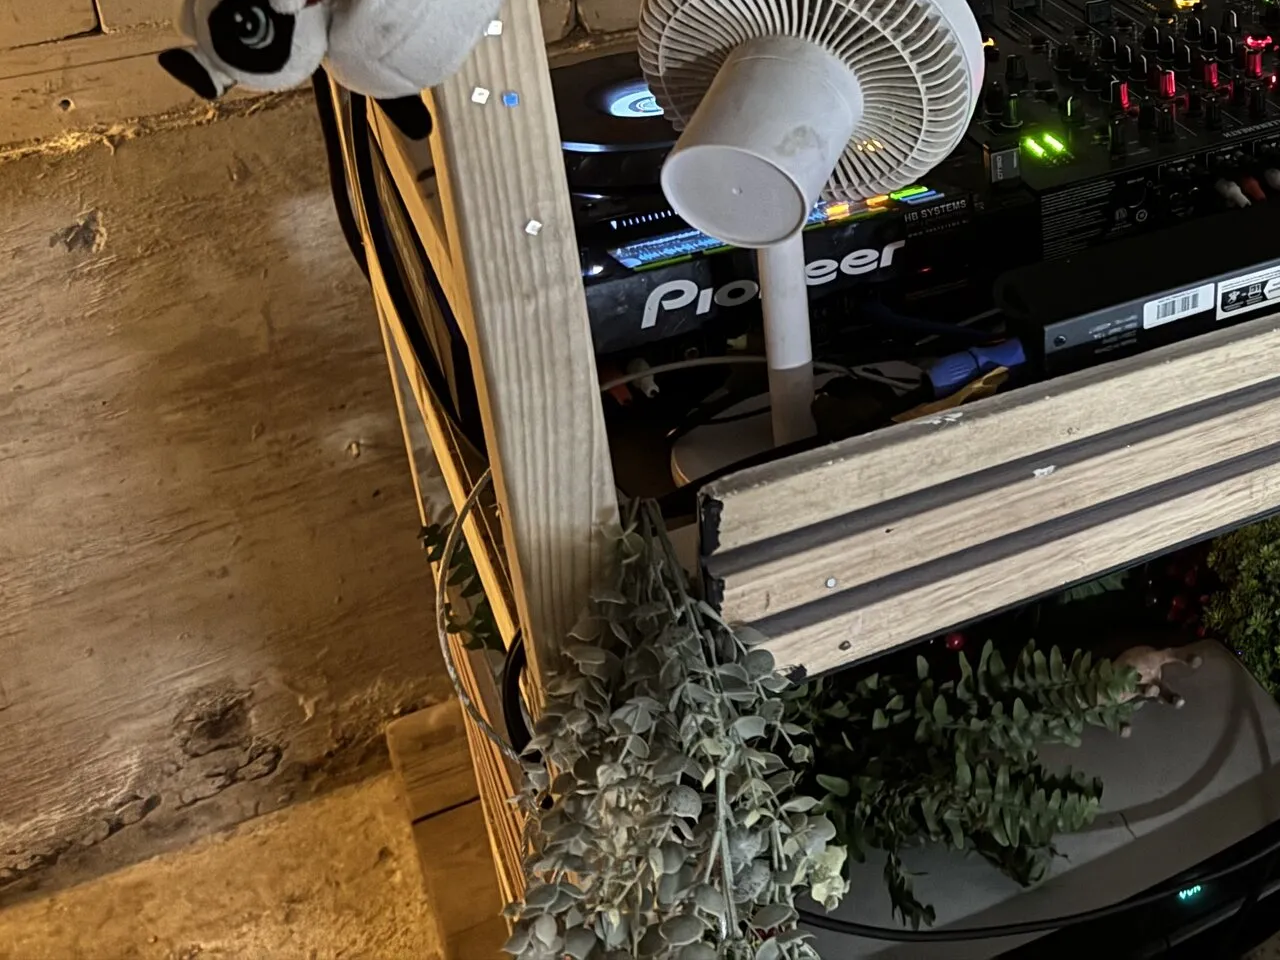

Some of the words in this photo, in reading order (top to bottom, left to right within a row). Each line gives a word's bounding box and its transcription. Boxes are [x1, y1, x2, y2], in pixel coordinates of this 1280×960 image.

[903, 210, 919, 224] HB
[921, 198, 968, 222] SYSTEMS
[641, 239, 906, 321] Pioeer
